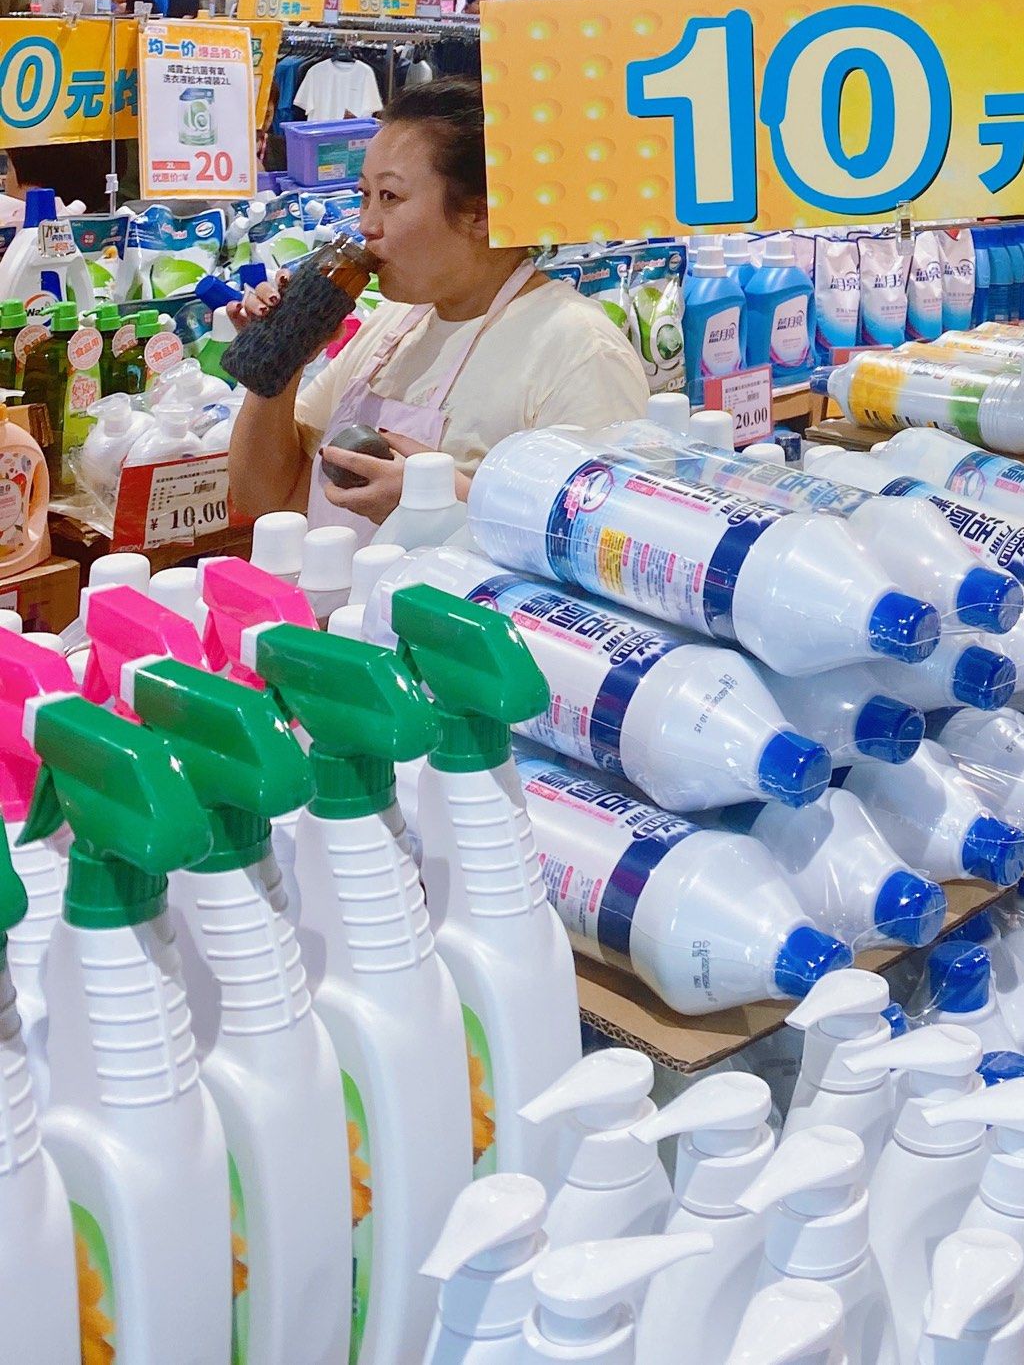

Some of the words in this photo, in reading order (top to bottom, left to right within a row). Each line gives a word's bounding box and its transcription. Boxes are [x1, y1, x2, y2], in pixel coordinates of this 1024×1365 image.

[148, 38, 196, 58] 均一价
[195, 151, 233, 183] 20
[777, 309, 805, 331] 蓝月亮
[708, 322, 736, 344] 蓝月亮
[75, 336, 100, 358] 食品用
[152, 343, 180, 361] 食品用
[735, 406, 768, 430] 20.00
[170, 501, 228, 530] 10.00
